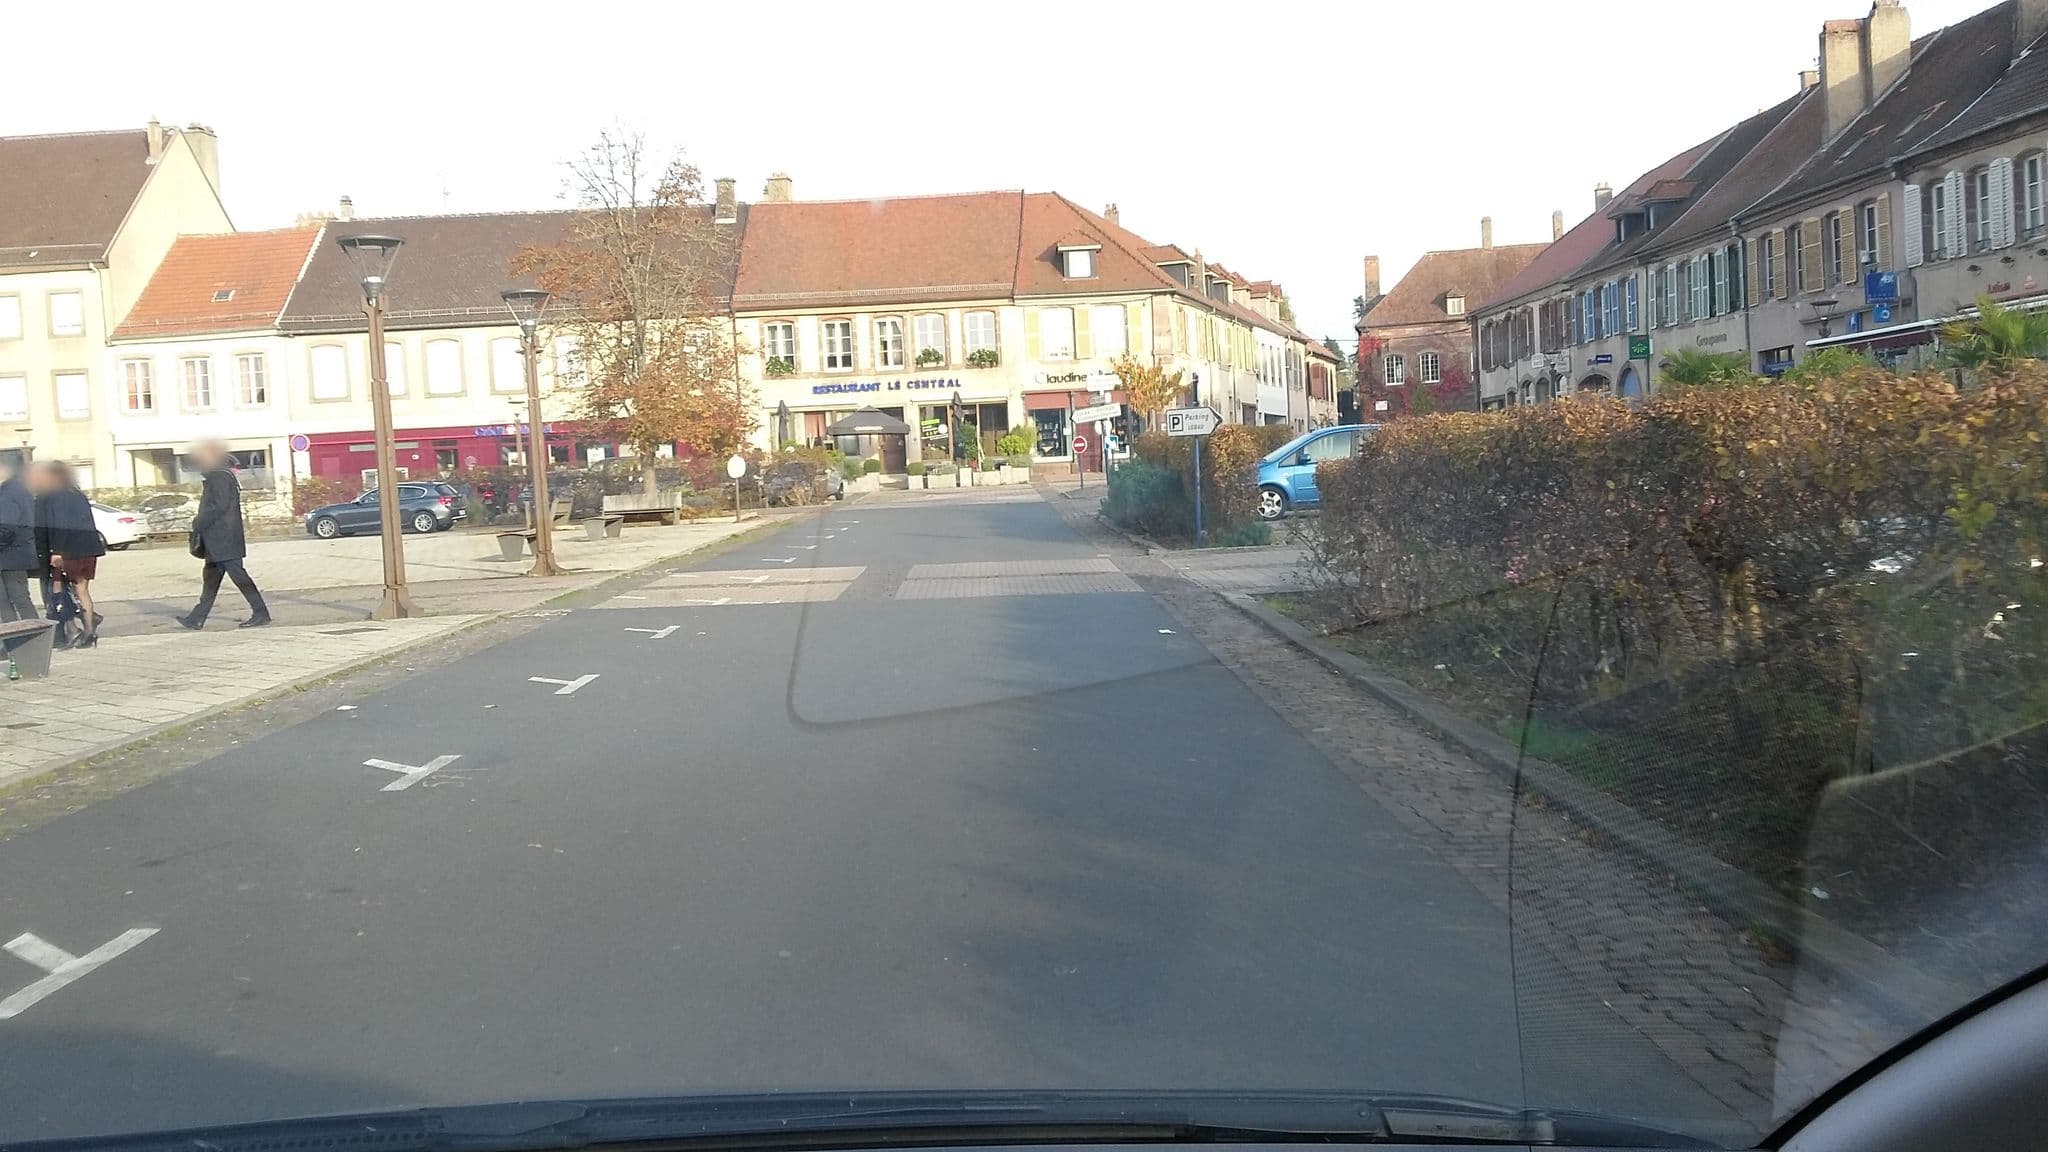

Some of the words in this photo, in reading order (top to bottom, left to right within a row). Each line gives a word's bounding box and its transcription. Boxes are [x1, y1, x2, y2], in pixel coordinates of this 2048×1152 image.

[812, 382, 880, 394] RESTAURANT
[888, 381, 900, 391] LE
[907, 379, 961, 389] CENTRAL
[1185, 414, 1209, 422] Parking
